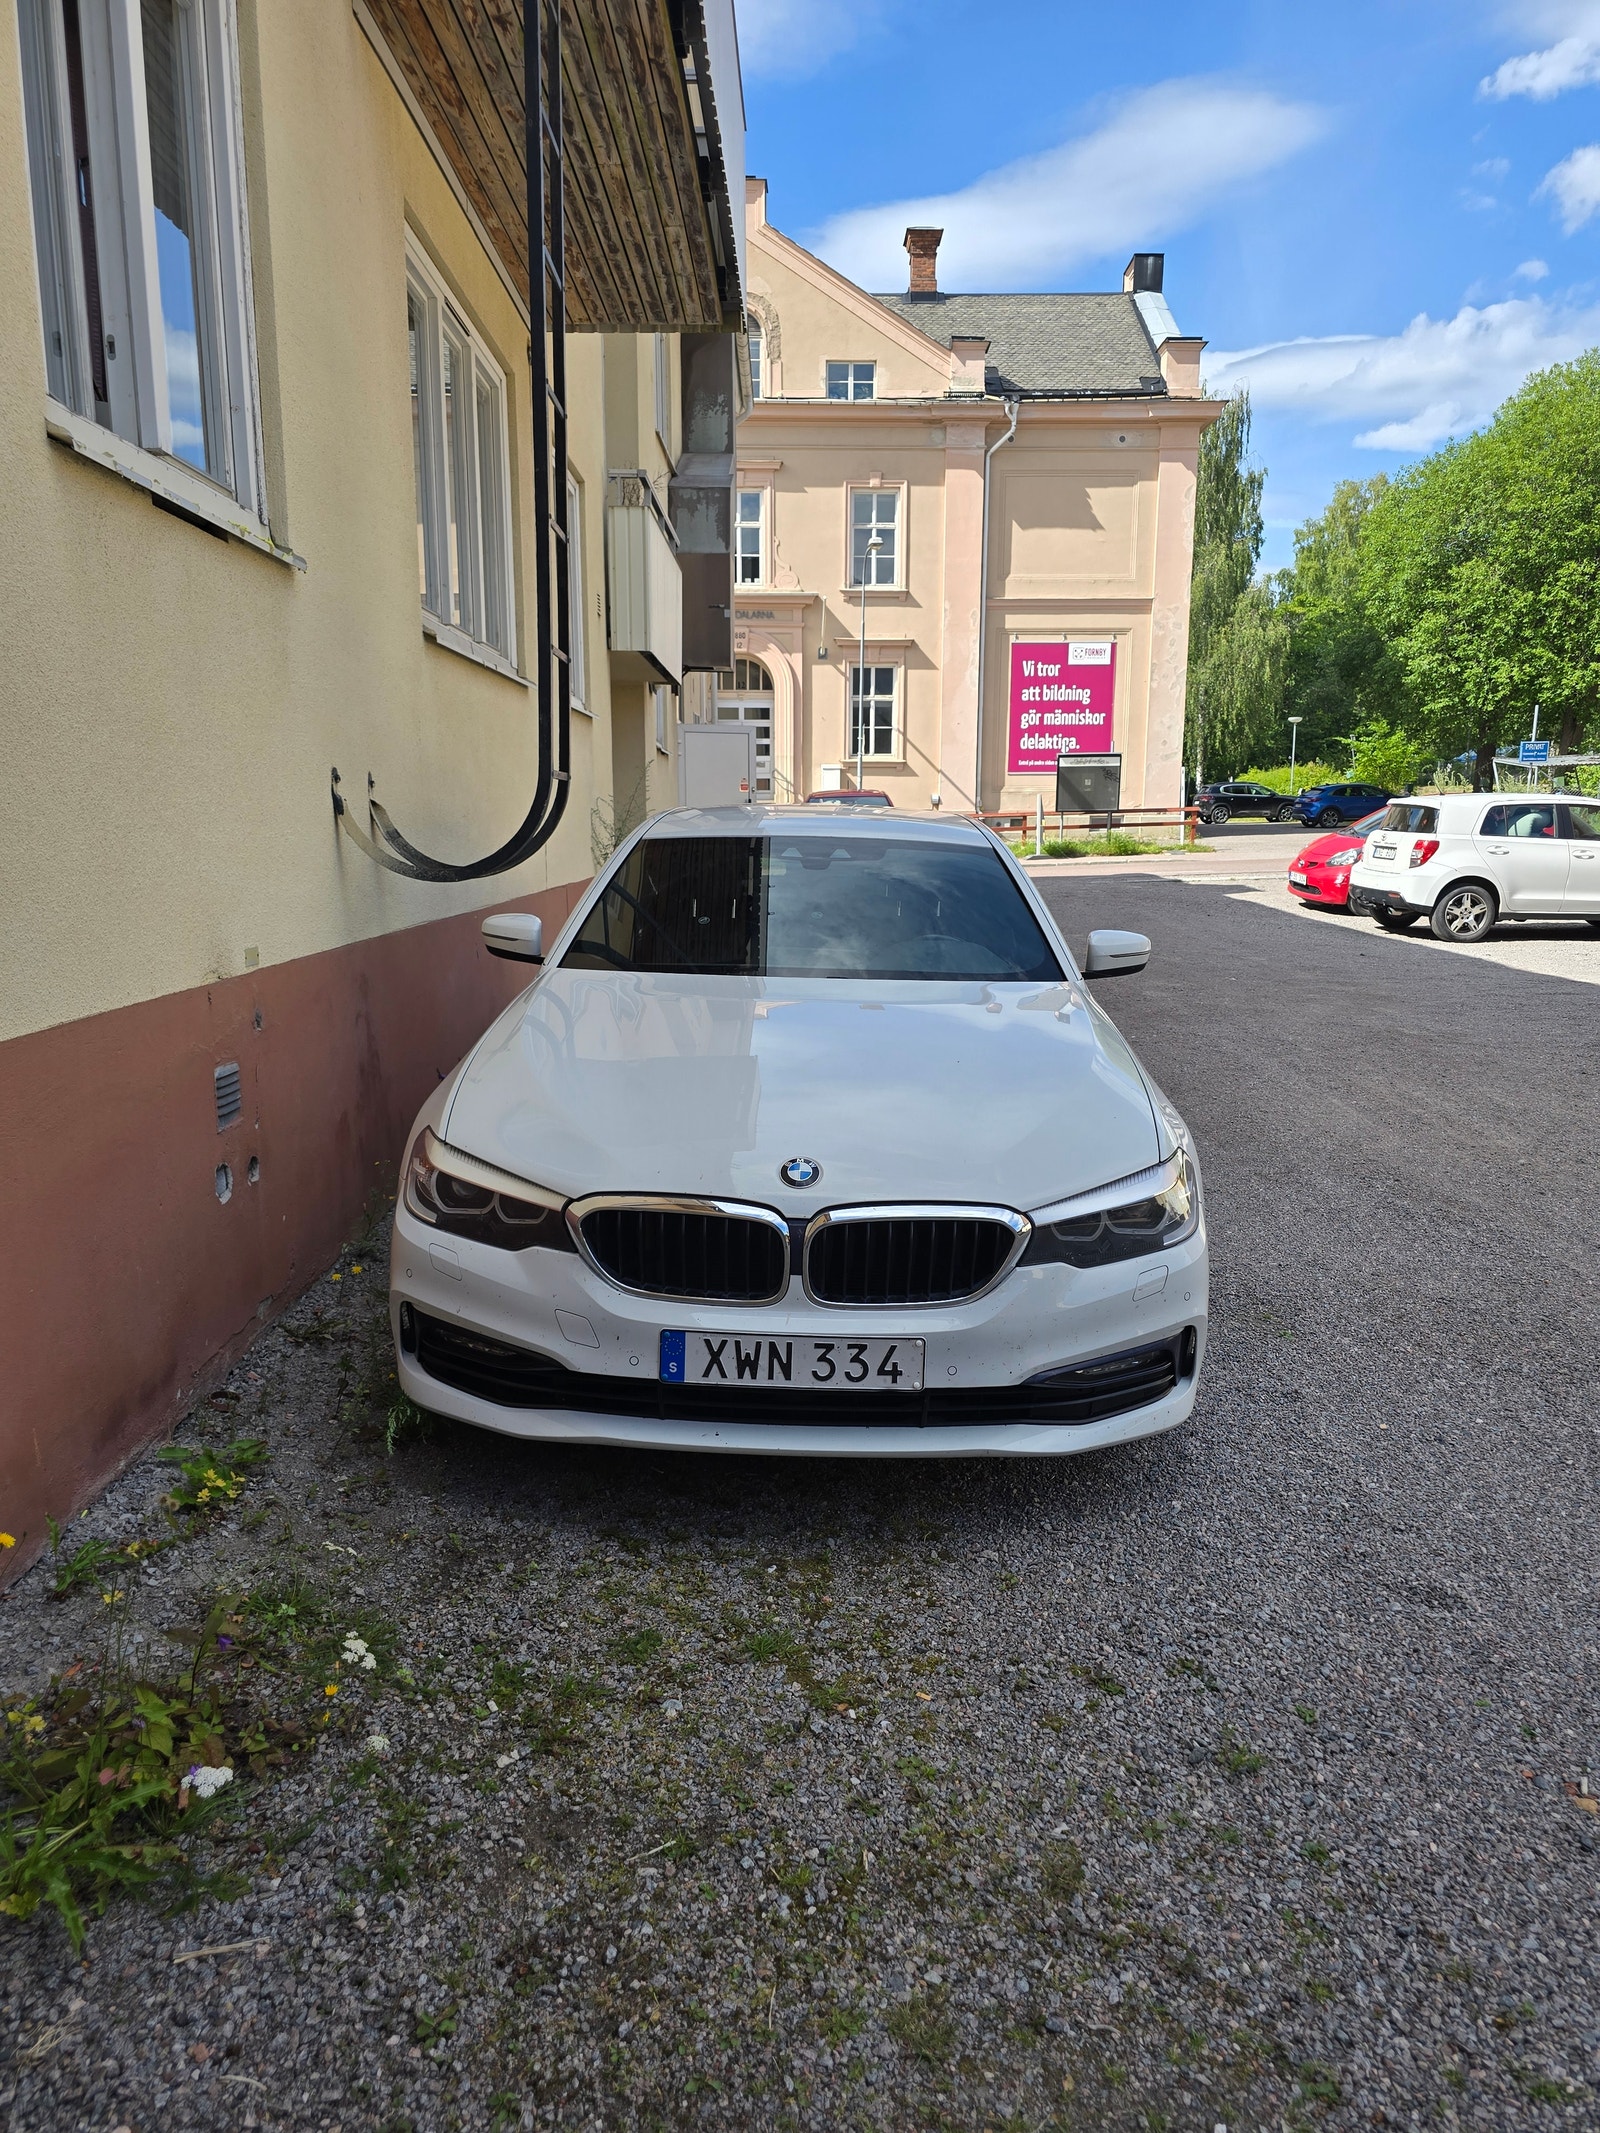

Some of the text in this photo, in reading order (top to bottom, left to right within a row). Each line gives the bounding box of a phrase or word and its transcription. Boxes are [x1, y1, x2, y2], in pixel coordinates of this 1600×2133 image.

[735, 610, 775, 619] DALARNA
[1085, 648, 1107, 656] FORNBY
[1022, 660, 1061, 677] Vi tror
[1021, 684, 1091, 705] att bildning
[1020, 708, 1106, 729] gör människor
[668, 1361, 678, 1373] S
[702, 1338, 902, 1384] XWN 334
